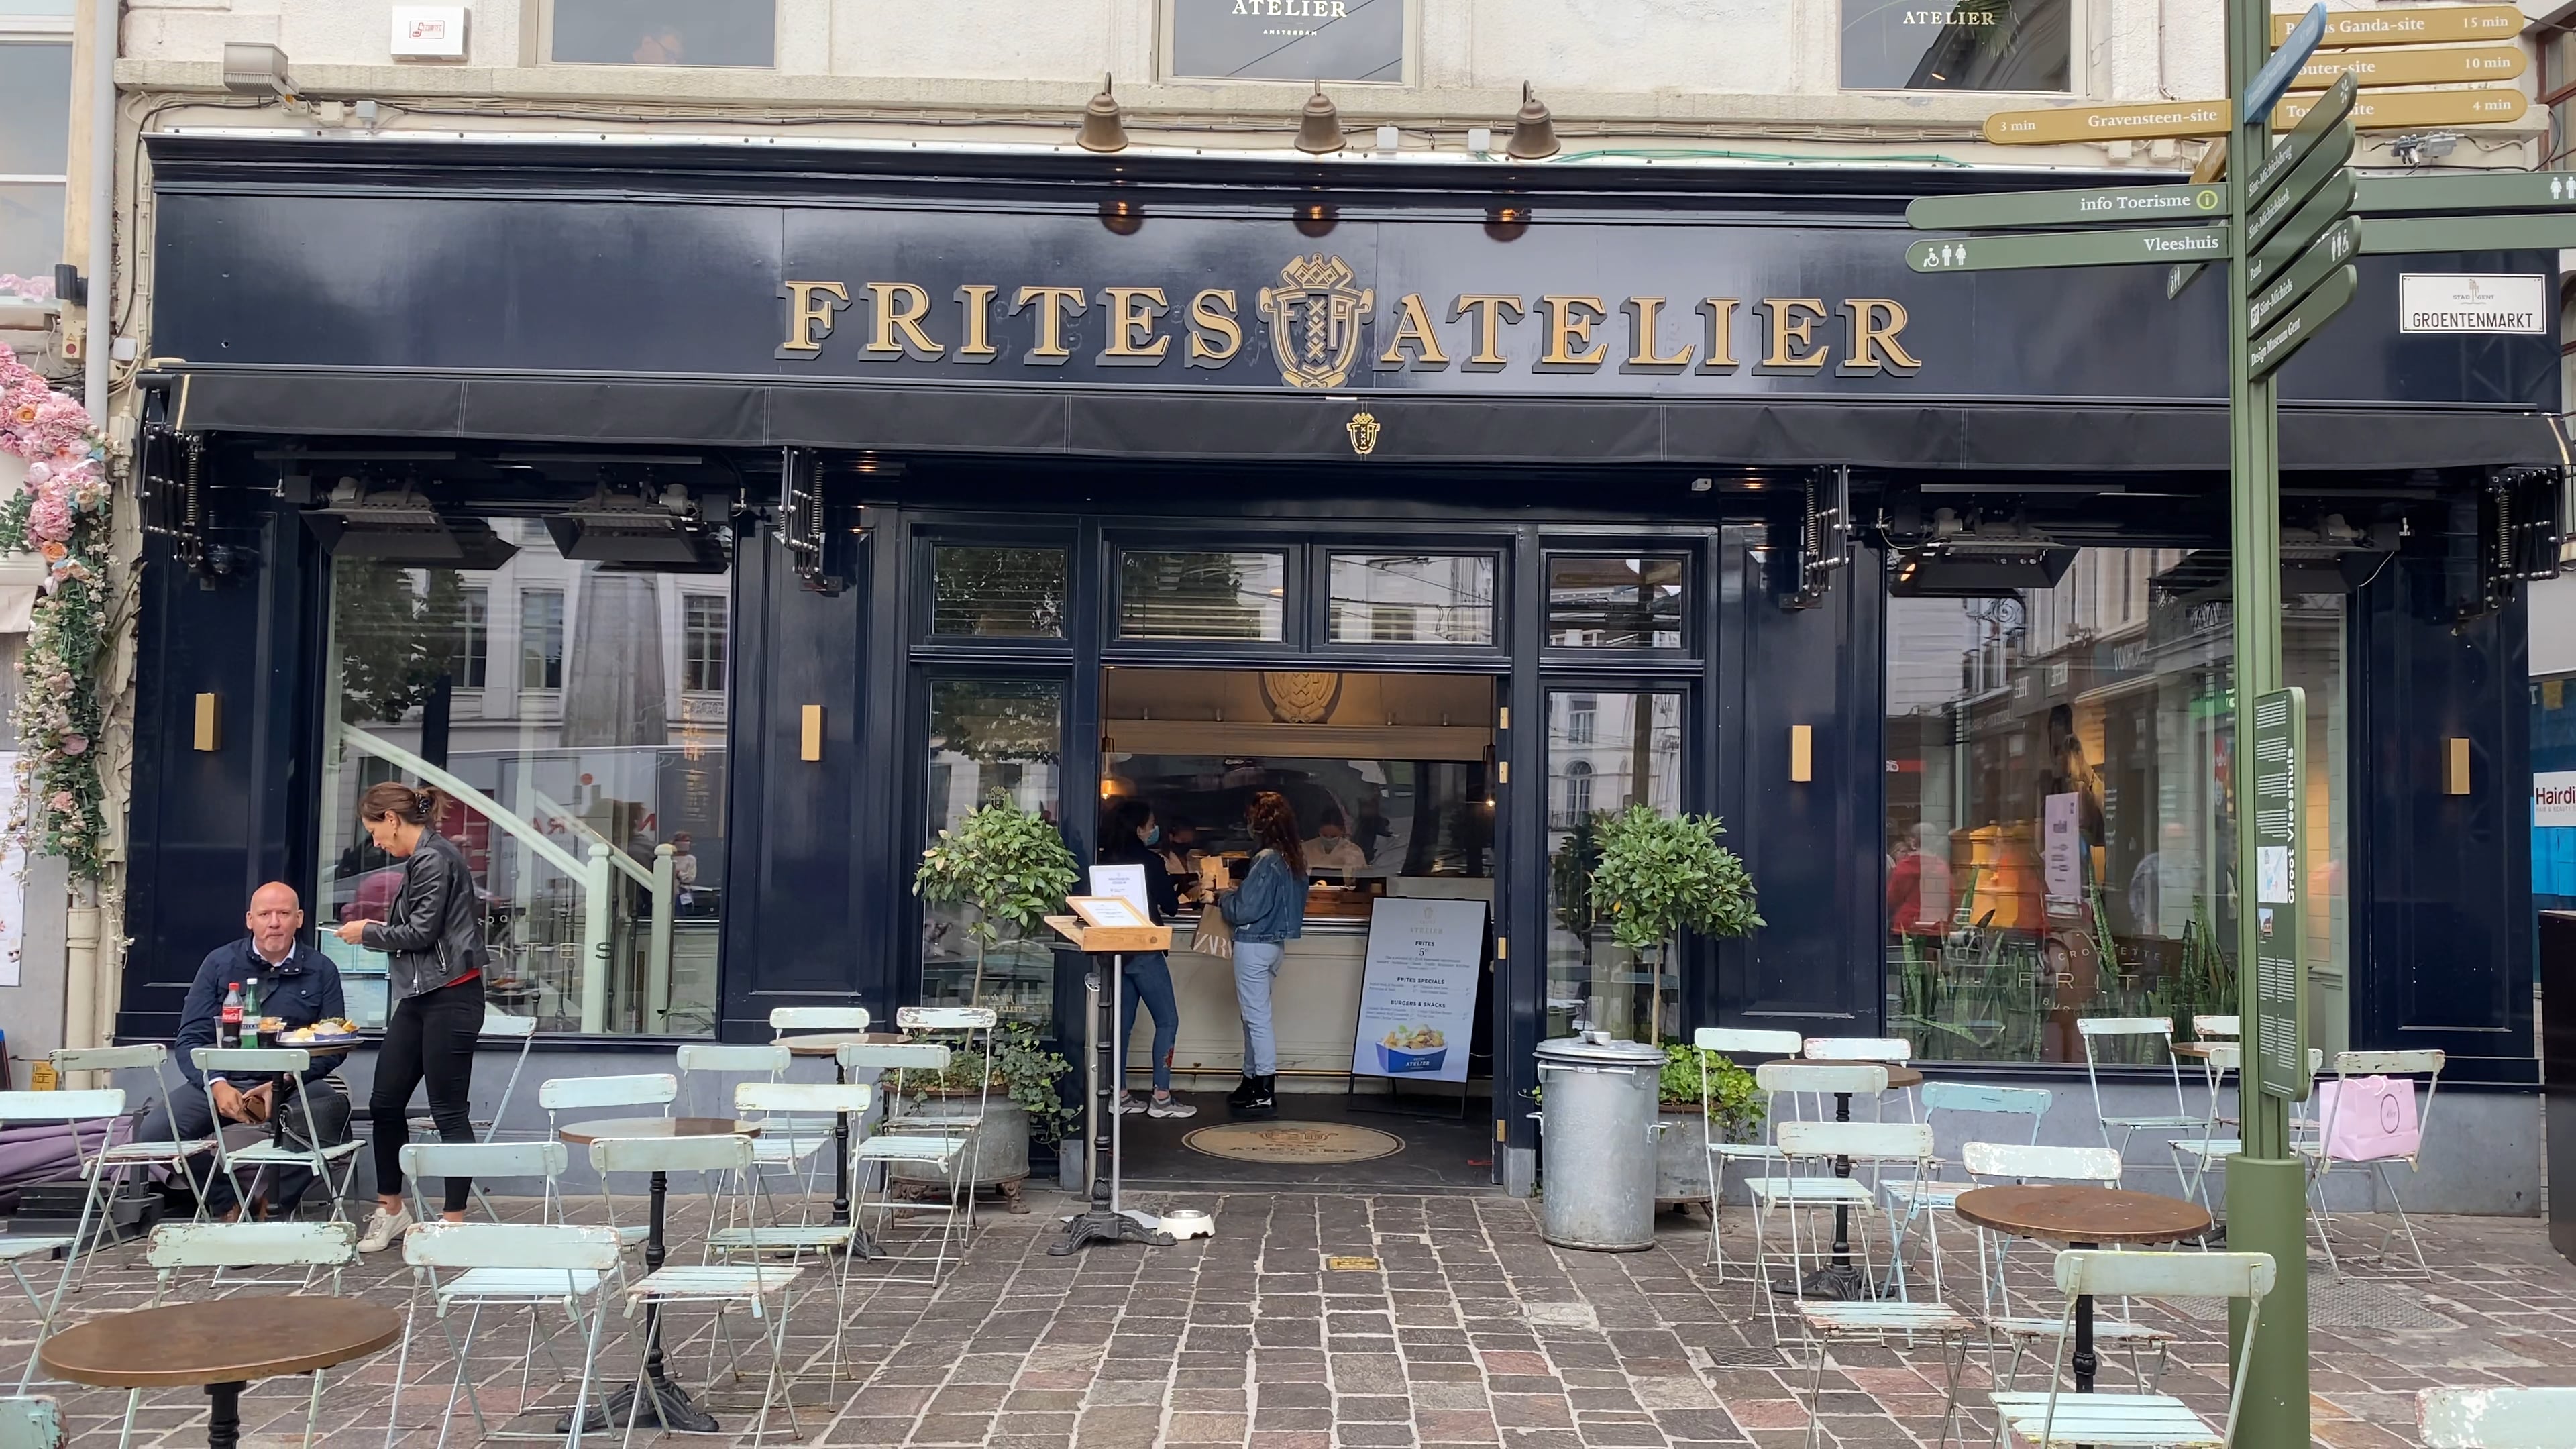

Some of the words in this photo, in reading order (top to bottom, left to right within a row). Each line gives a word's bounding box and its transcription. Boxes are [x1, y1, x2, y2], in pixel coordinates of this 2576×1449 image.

[1232, 0, 1347, 17] ATELIER
[1902, 11, 1995, 25] ATELIER
[2339, 17, 2425, 33] Ganda-site
[2463, 17, 2477, 28] 15
[2482, 16, 2509, 27] min
[2466, 58, 2480, 68] 10
[2485, 56, 2511, 68] min
[2473, 101, 2481, 111] 4
[2485, 99, 2512, 111] min
[2000, 121, 2007, 132] 3
[2010, 120, 2037, 131] min
[2088, 109, 2218, 127] Gravensteen-site
[2080, 196, 2113, 211] info
[2116, 193, 2191, 209] Toerisme
[2144, 235, 2219, 252] Vleeshuis
[2259, 278, 2293, 316] Sint-Michiels
[775, 280, 1244, 369] FRITES
[1373, 292, 1923, 378] ATELIER
[2412, 312, 2534, 329] GROENTENMARKT
[2251, 347, 2267, 366] Design
[2267, 329, 2288, 354] Museum
[2288, 317, 2301, 336] Gent
[2286, 747, 2294, 843] Vleeshuis
[2287, 848, 2295, 904] Groot
